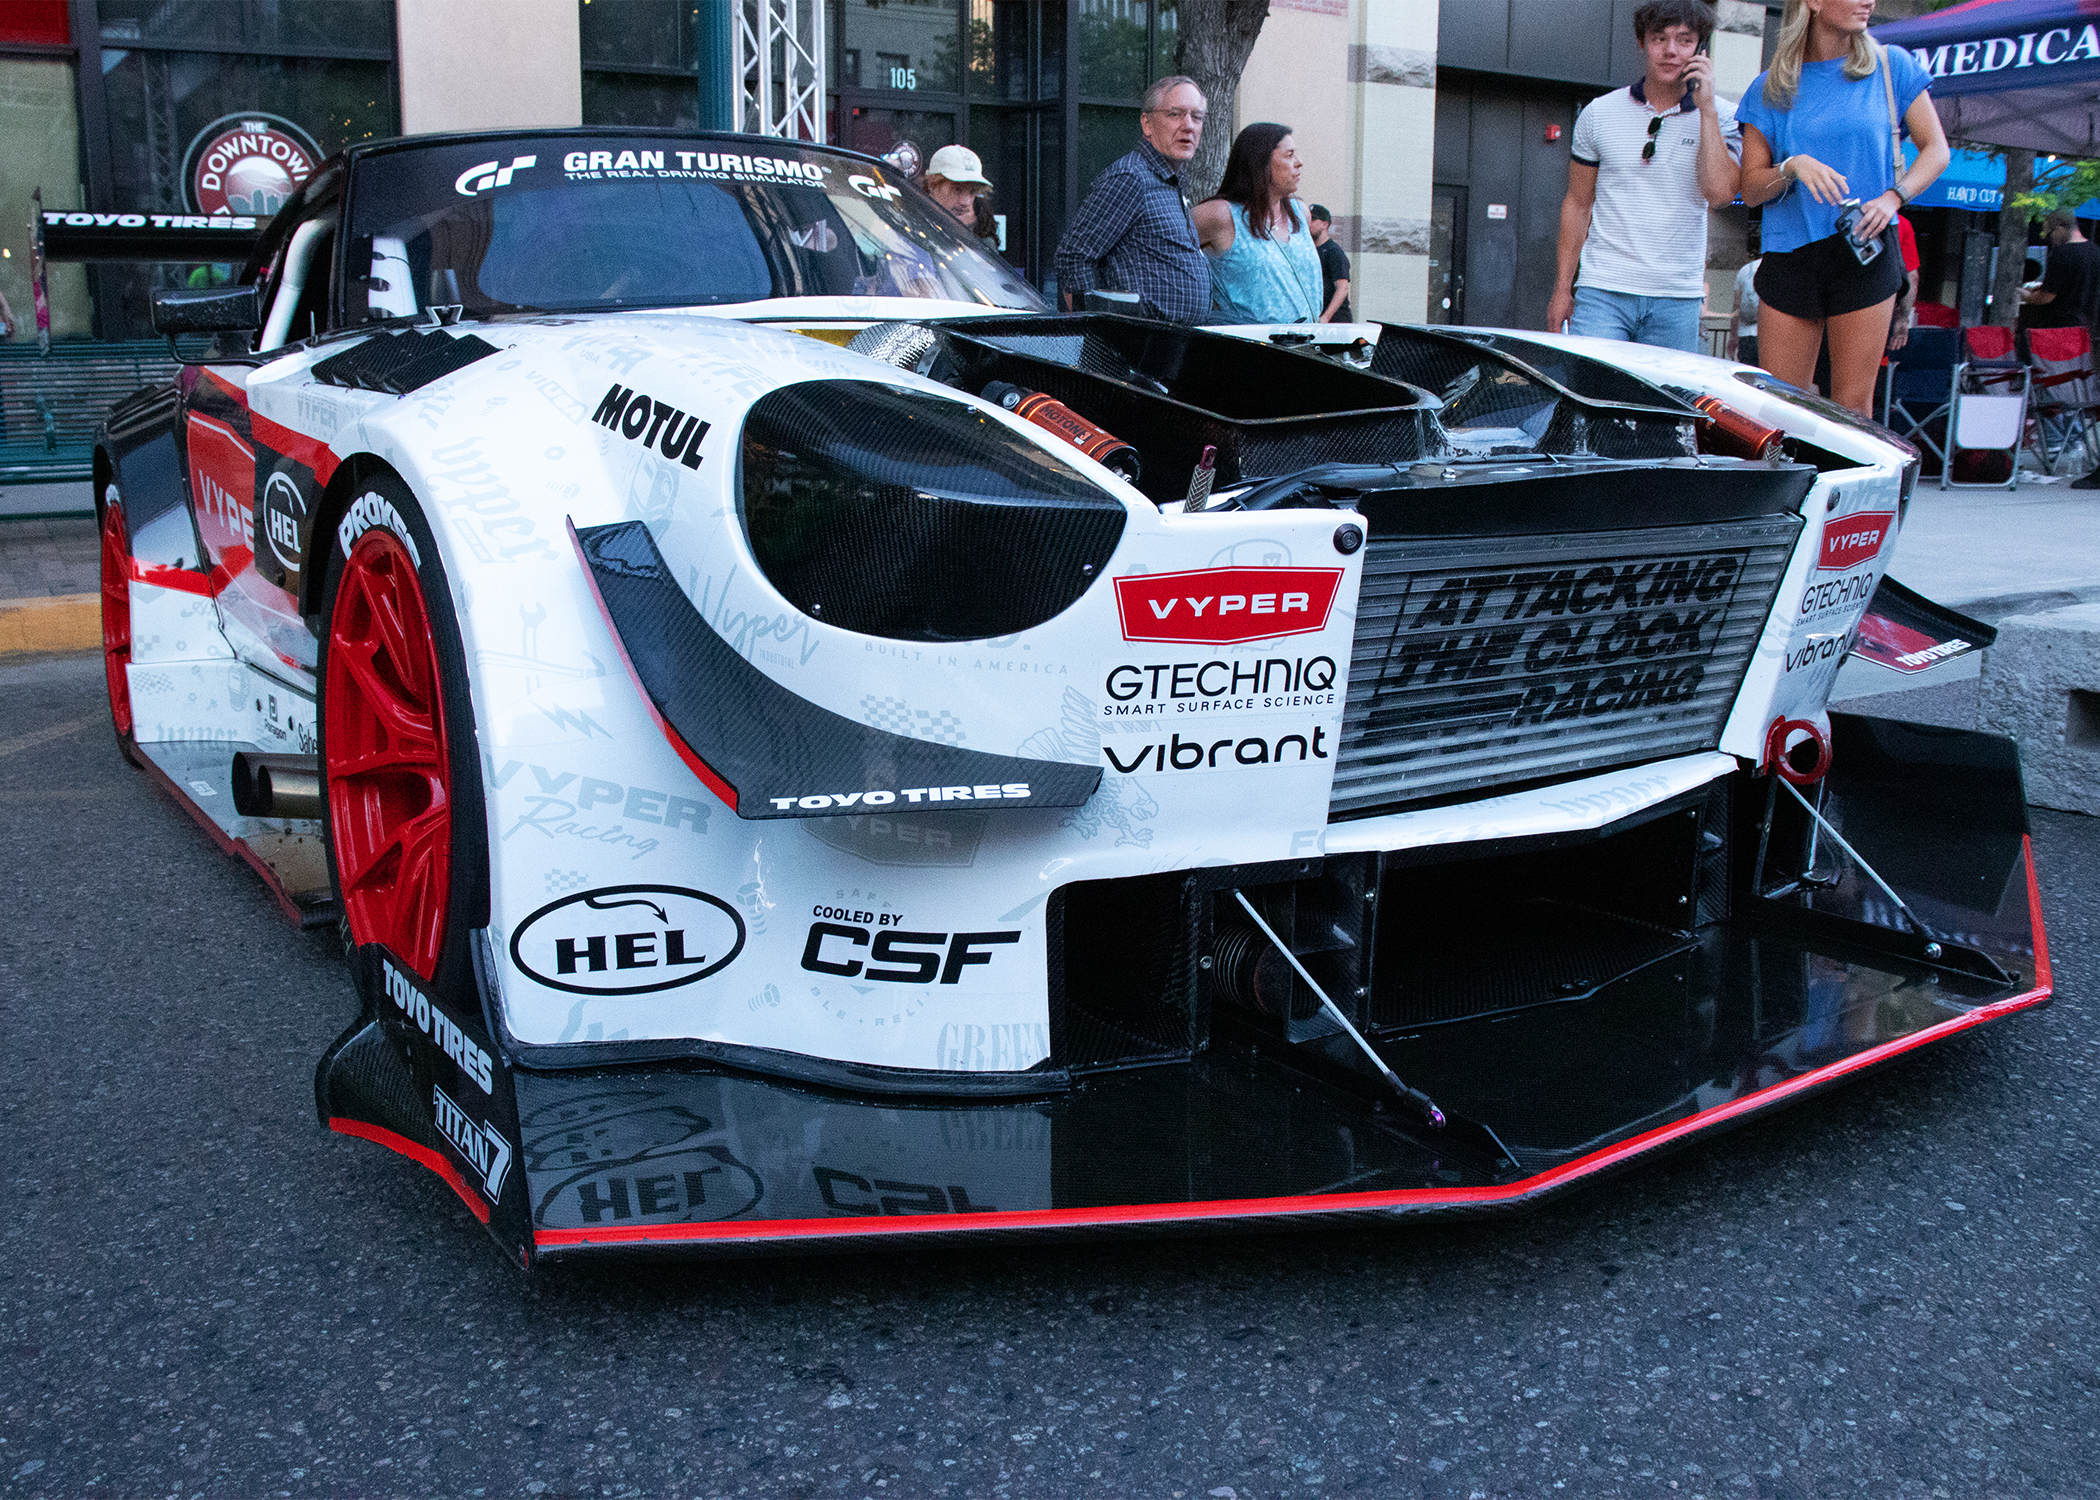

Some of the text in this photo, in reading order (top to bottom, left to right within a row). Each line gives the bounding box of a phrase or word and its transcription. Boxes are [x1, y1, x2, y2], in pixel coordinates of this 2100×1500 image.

[890, 67, 916, 90] 105
[245, 122, 266, 133] THE
[202, 134, 309, 191] DOWNTOW
[564, 150, 665, 172] GRAN
[565, 170, 827, 189] THE REAL DRIVING SIMULATOR
[42, 212, 256, 229] TOYO TIRES
[592, 383, 711, 471] MOTUL
[1038, 406, 1083, 435] MOTON
[199, 469, 254, 553] VYPE
[271, 508, 301, 554] HEL
[1829, 530, 1880, 553] VYPER
[1147, 592, 1309, 620] VYPER
[1409, 557, 1738, 630] ATTACKING
[1802, 572, 1873, 614] GTECHNIQ
[1796, 601, 1866, 627] SMART SURFACE SCIENCE
[865, 641, 1069, 675] BUILT IN AMERICA
[1392, 609, 1726, 688] THE CLOCK
[1895, 638, 1972, 667] TOYO TIRES
[1106, 655, 1337, 701] GTECHNIQ
[1511, 664, 1705, 728] RACING
[1103, 694, 1335, 716] SMART SURFACE SCIENCE
[1102, 725, 1329, 774] vibrant
[485, 753, 713, 835] VYPER
[769, 783, 1032, 810] TOYO TIRES
[501, 796, 660, 861] Racing
[822, 815, 953, 849] YPER
[812, 904, 904, 928] COOLED BY
[556, 928, 707, 975] HEL
[800, 921, 1022, 985] CSF
[383, 958, 430, 1034] TOYO
[432, 1004, 493, 1095] TIRES
